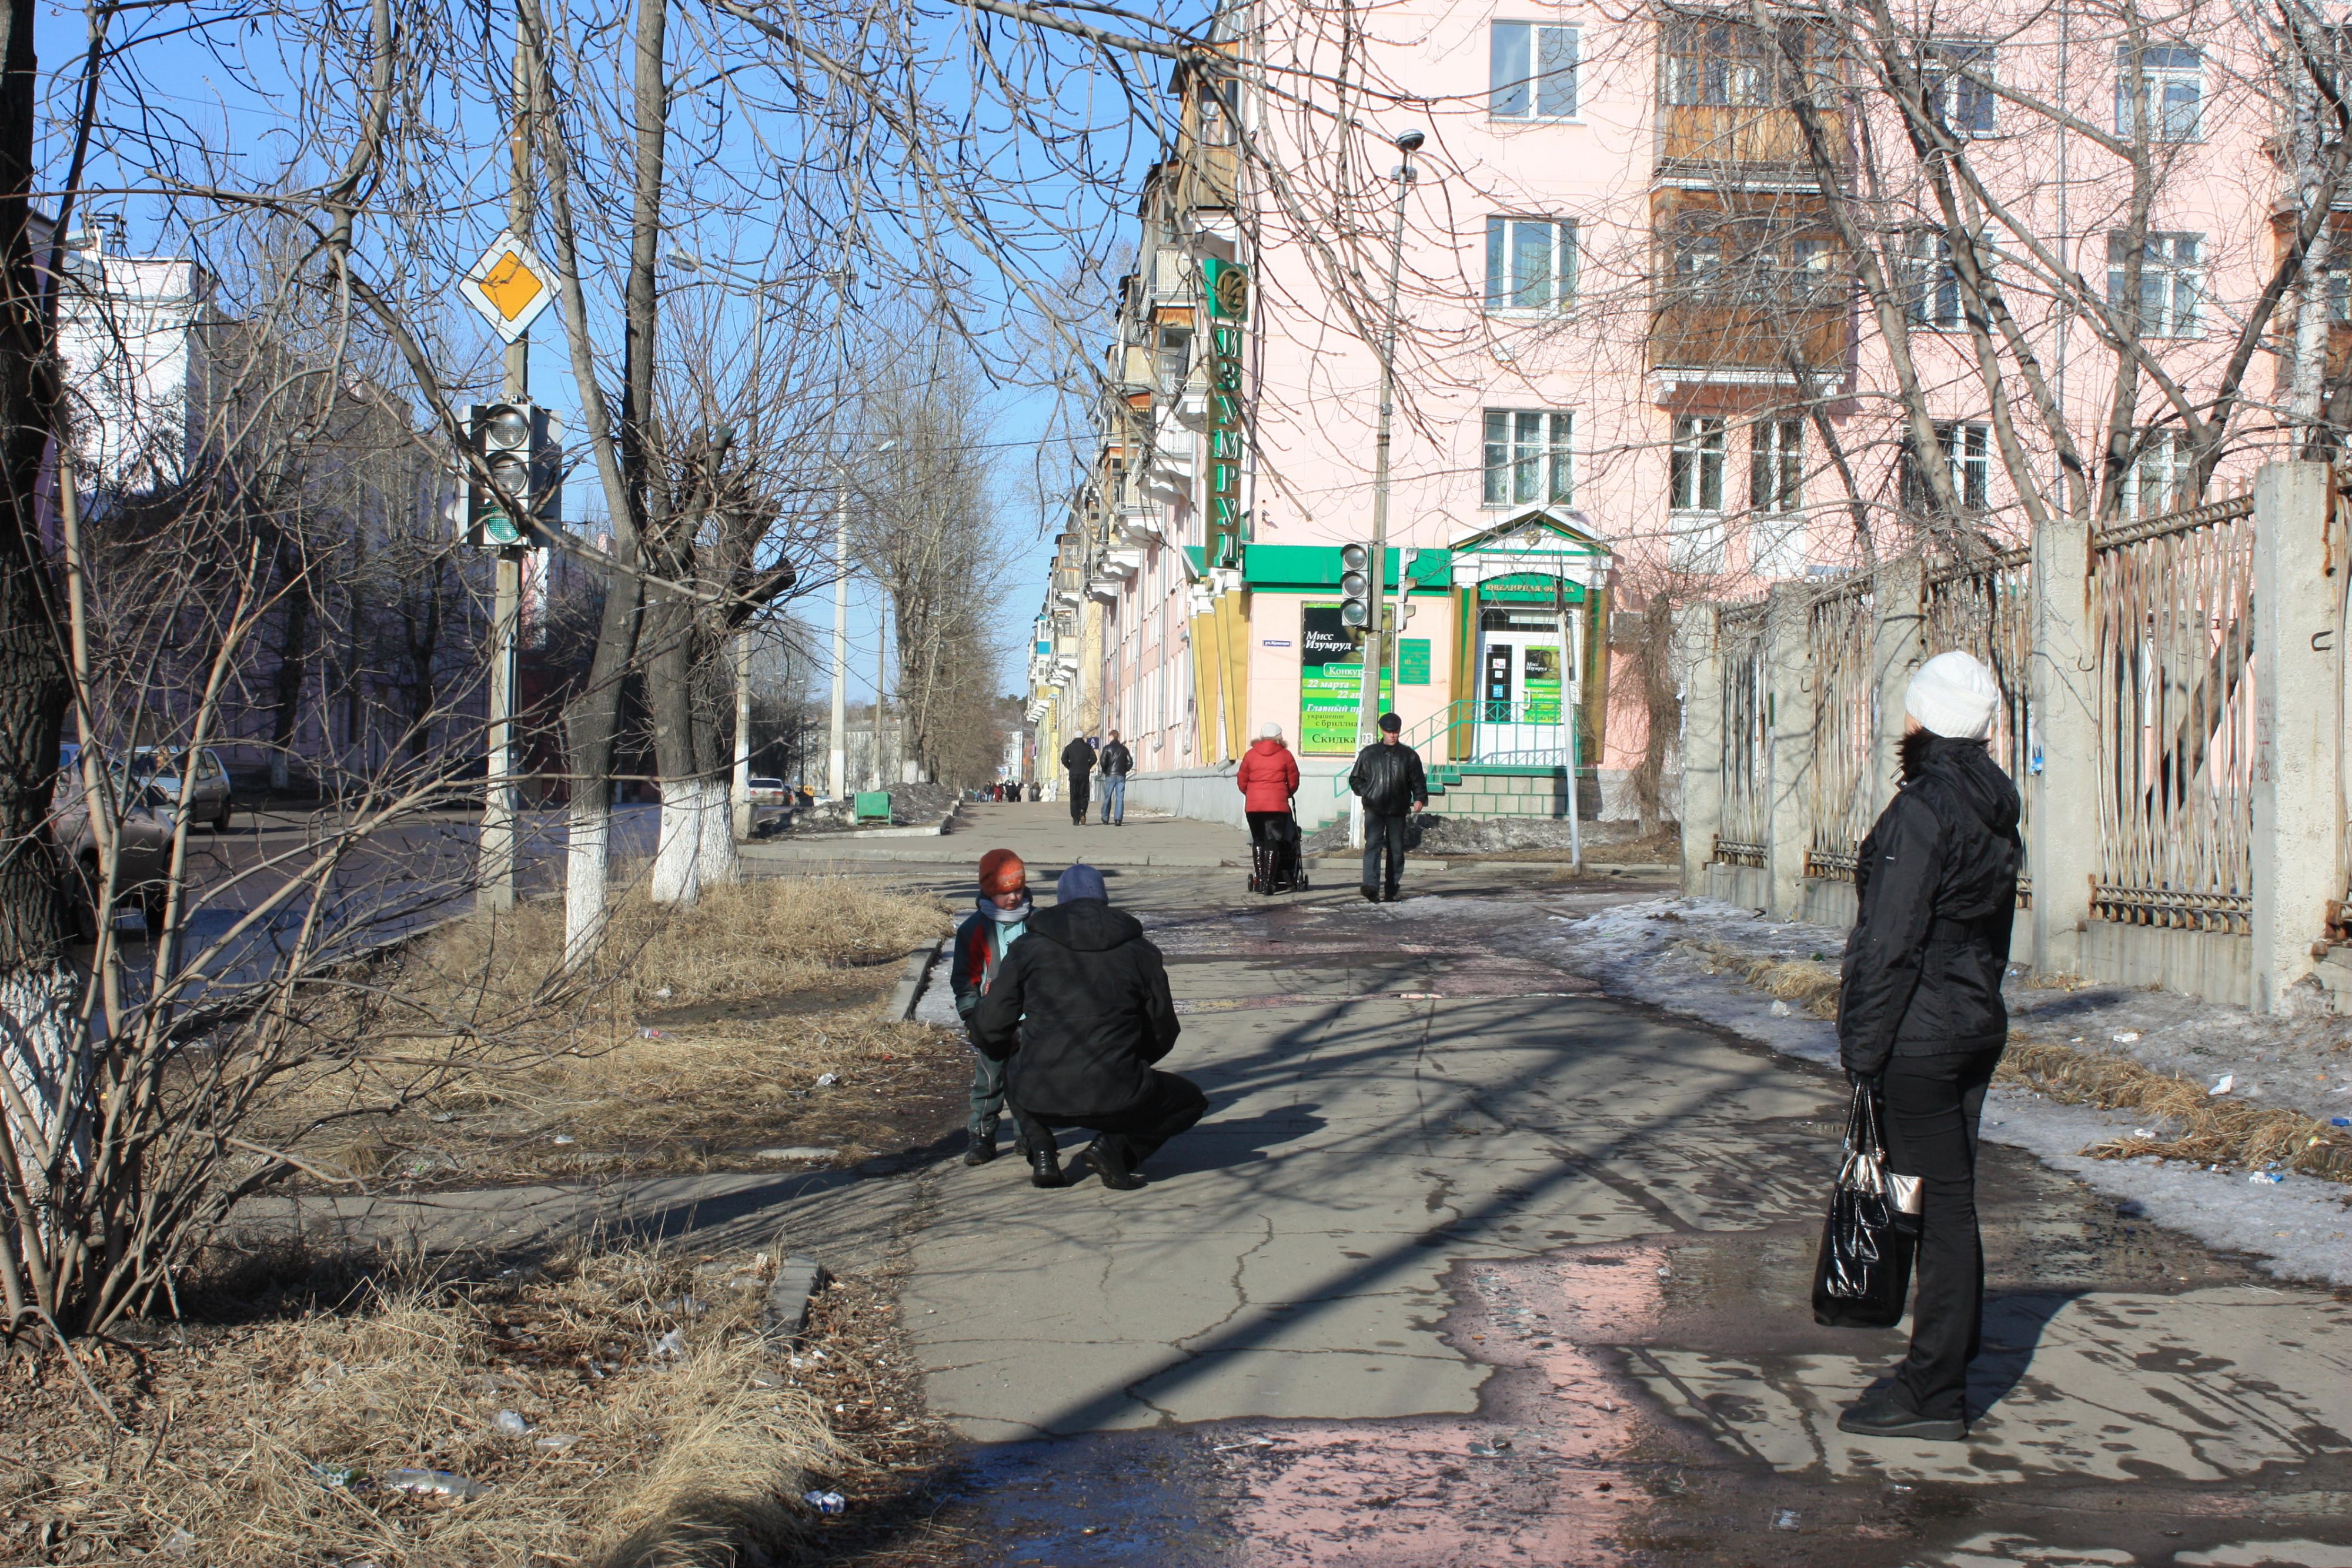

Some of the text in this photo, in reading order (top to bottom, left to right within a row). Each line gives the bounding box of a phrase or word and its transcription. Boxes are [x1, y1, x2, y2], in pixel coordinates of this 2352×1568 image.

[1213, 328, 1243, 569] ИЗУМРУД
[1485, 584, 1541, 593] ЮВЕЛИРНАЯ
[1306, 631, 1334, 641] Мисс
[1305, 640, 1352, 651] Изумруд
[1329, 666, 1364, 677] Конкур
[1307, 679, 1319, 688] 22
[1320, 681, 1349, 690] марта
[1337, 690, 1348, 699] 22
[1307, 704, 1348, 712] Главный
[1312, 734, 1356, 744] Скидка
